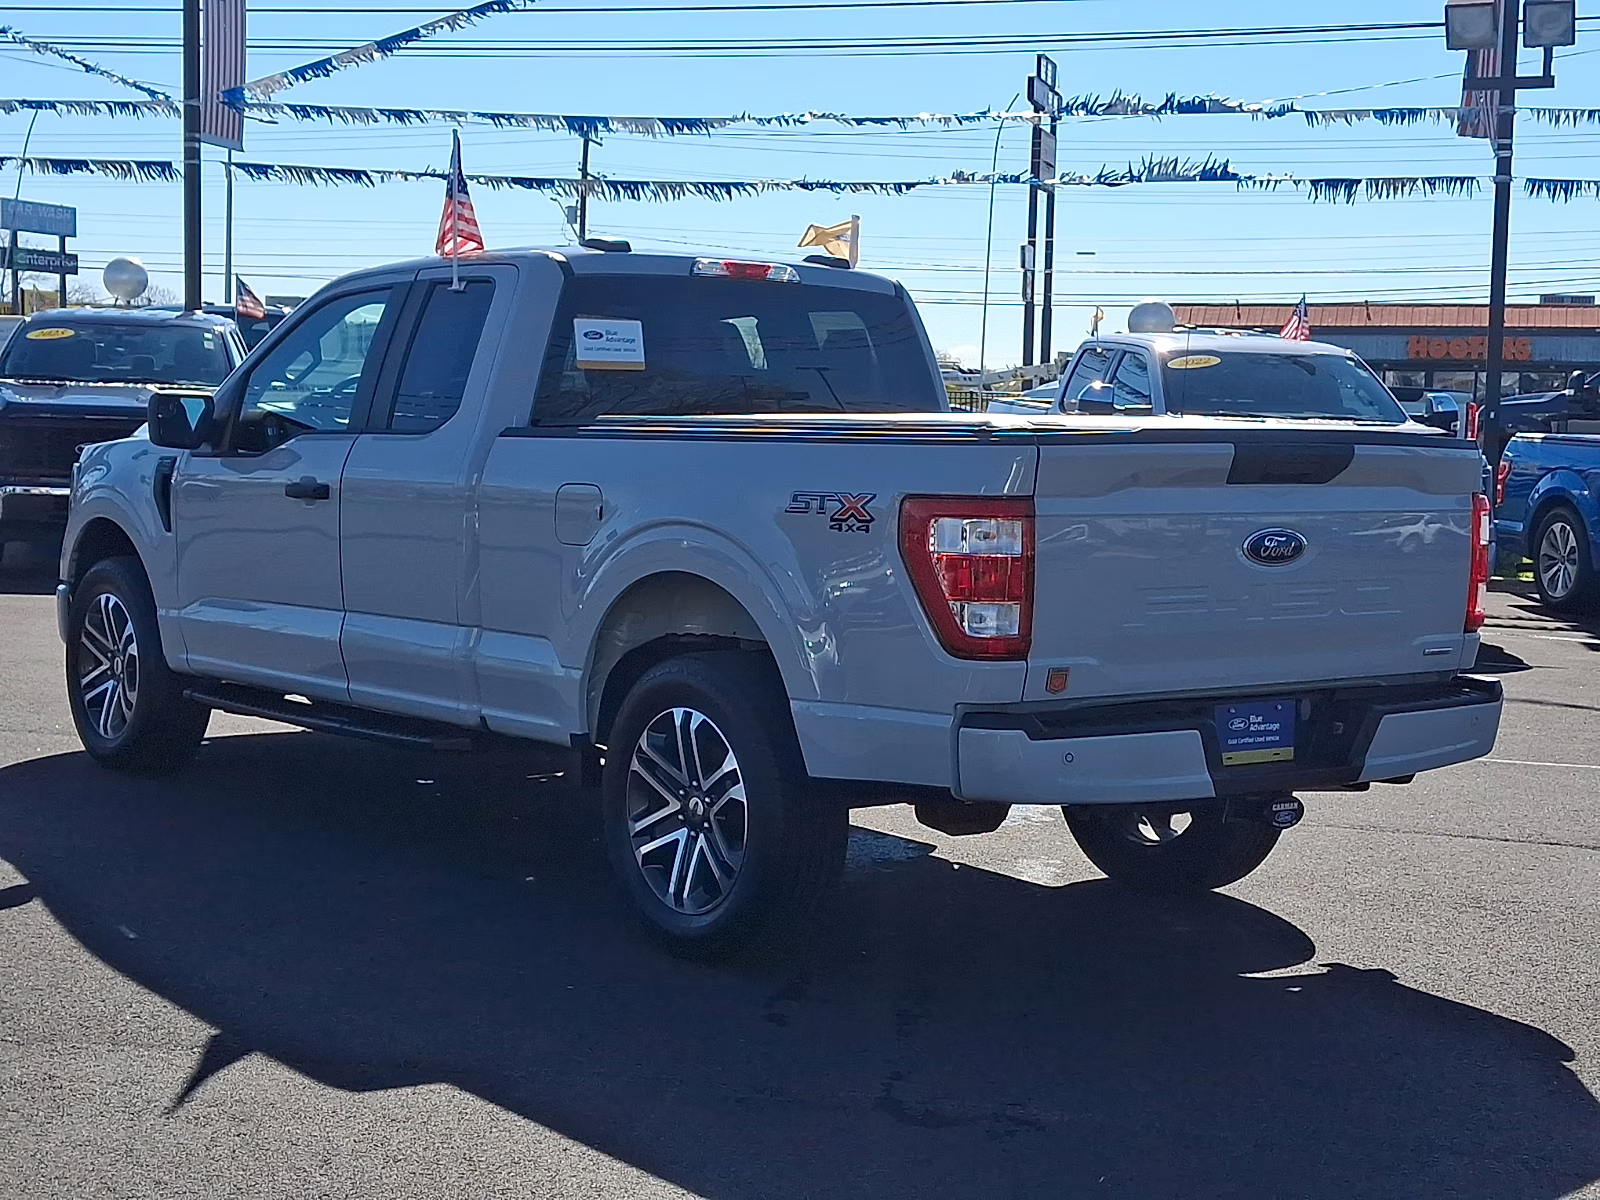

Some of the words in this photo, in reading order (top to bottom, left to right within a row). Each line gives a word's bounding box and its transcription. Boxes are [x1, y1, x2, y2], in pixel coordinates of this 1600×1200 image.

[8, 201, 33, 216] CAR
[39, 205, 71, 219] WASH
[1408, 335, 1531, 360] HOOTRS
[784, 491, 878, 524] STX
[1260, 535, 1296, 557] Ford
[1249, 714, 1264, 723] Blue
[1249, 722, 1281, 732] Advantage
[1272, 802, 1299, 811] CARMAN
